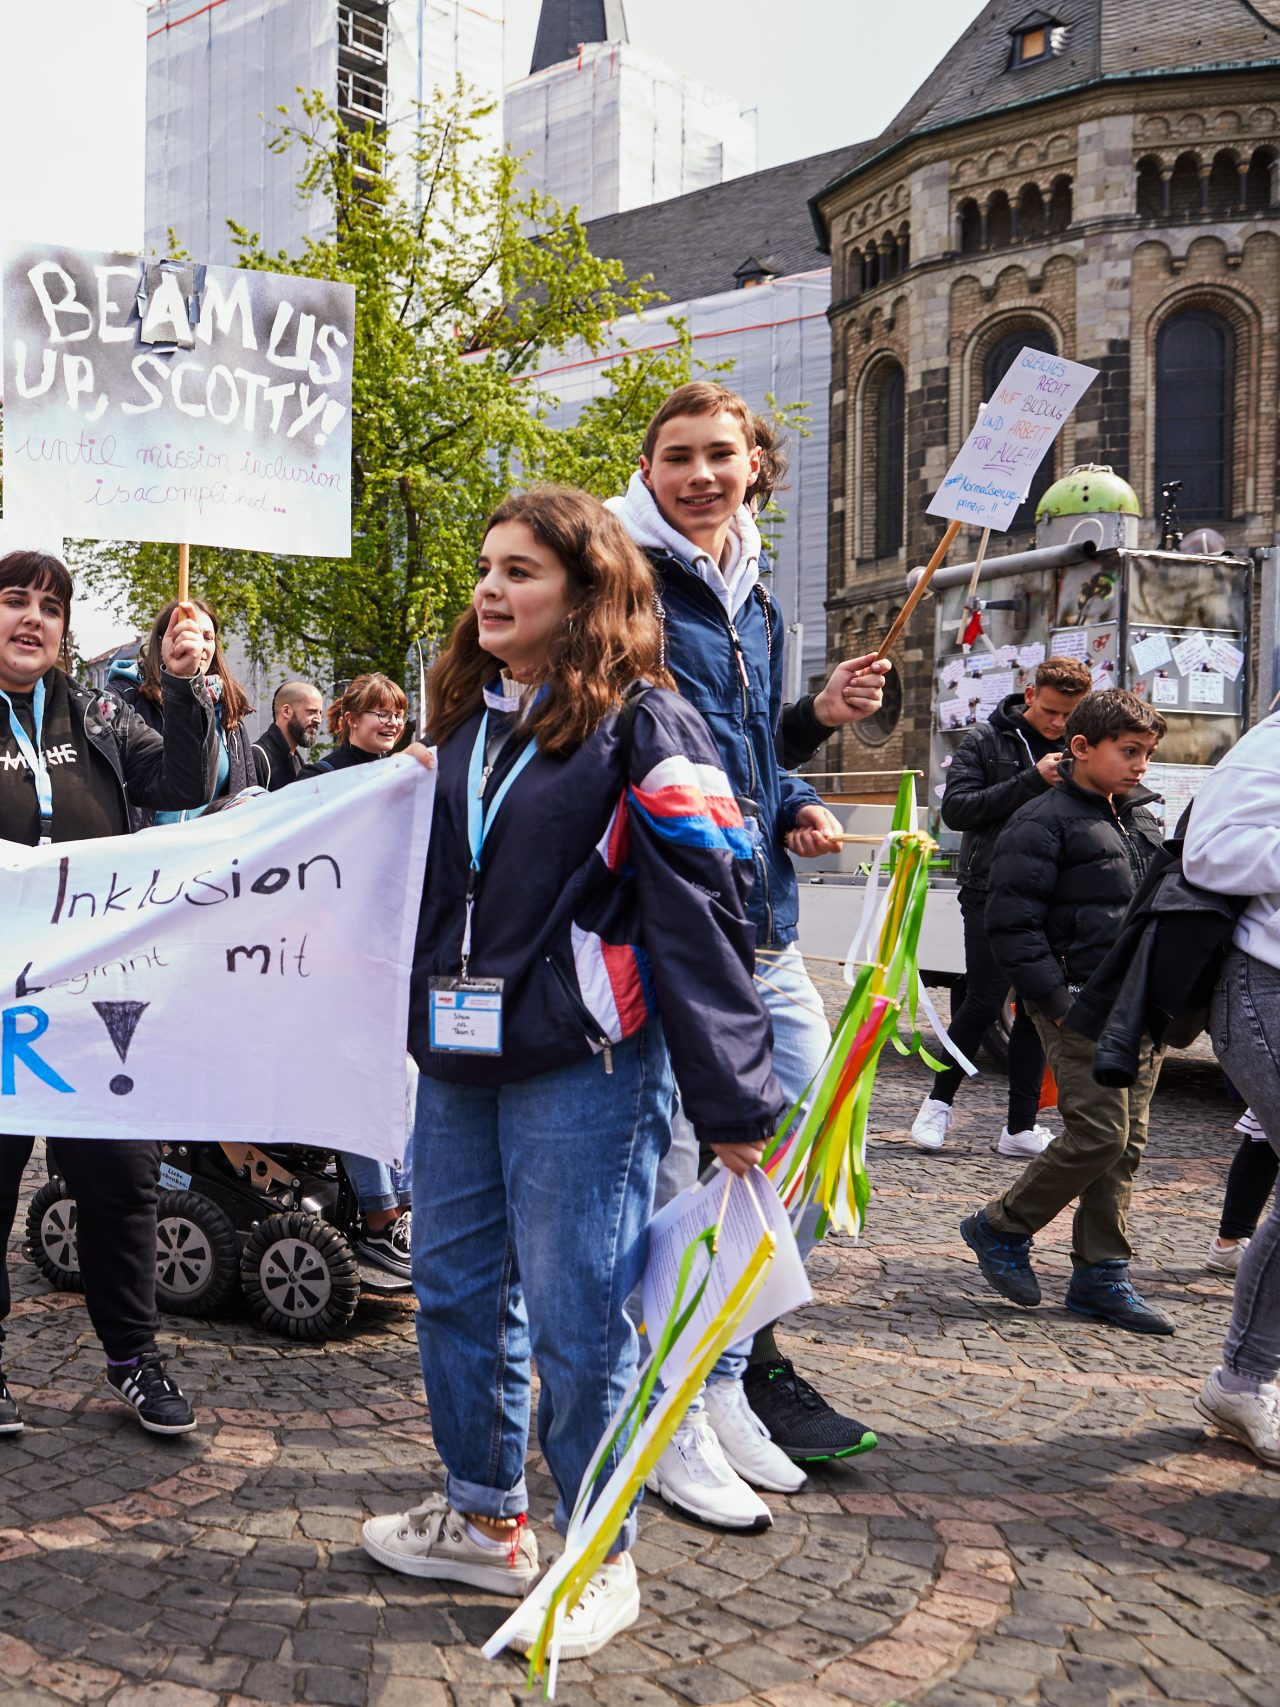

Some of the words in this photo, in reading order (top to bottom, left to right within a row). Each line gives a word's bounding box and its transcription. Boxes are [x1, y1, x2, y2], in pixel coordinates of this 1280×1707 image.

[27, 260, 258, 351] BEAM
[265, 300, 349, 386] US
[1021, 352, 1068, 378] GLEICHES
[1036, 375, 1071, 397] RECHT
[14, 340, 110, 422] UP,
[121, 353, 348, 446] SCOTTY!
[996, 388, 1022, 405] AUF
[1020, 395, 1068, 421] BILDUNG
[982, 415, 1004, 431] UND
[1008, 419, 1052, 442] ARBEIT
[15, 430, 127, 468] until
[136, 443, 232, 473] mission
[240, 450, 344, 492] inclusion
[51, 855, 341, 925] Inklusion
[225, 931, 311, 978] mit
